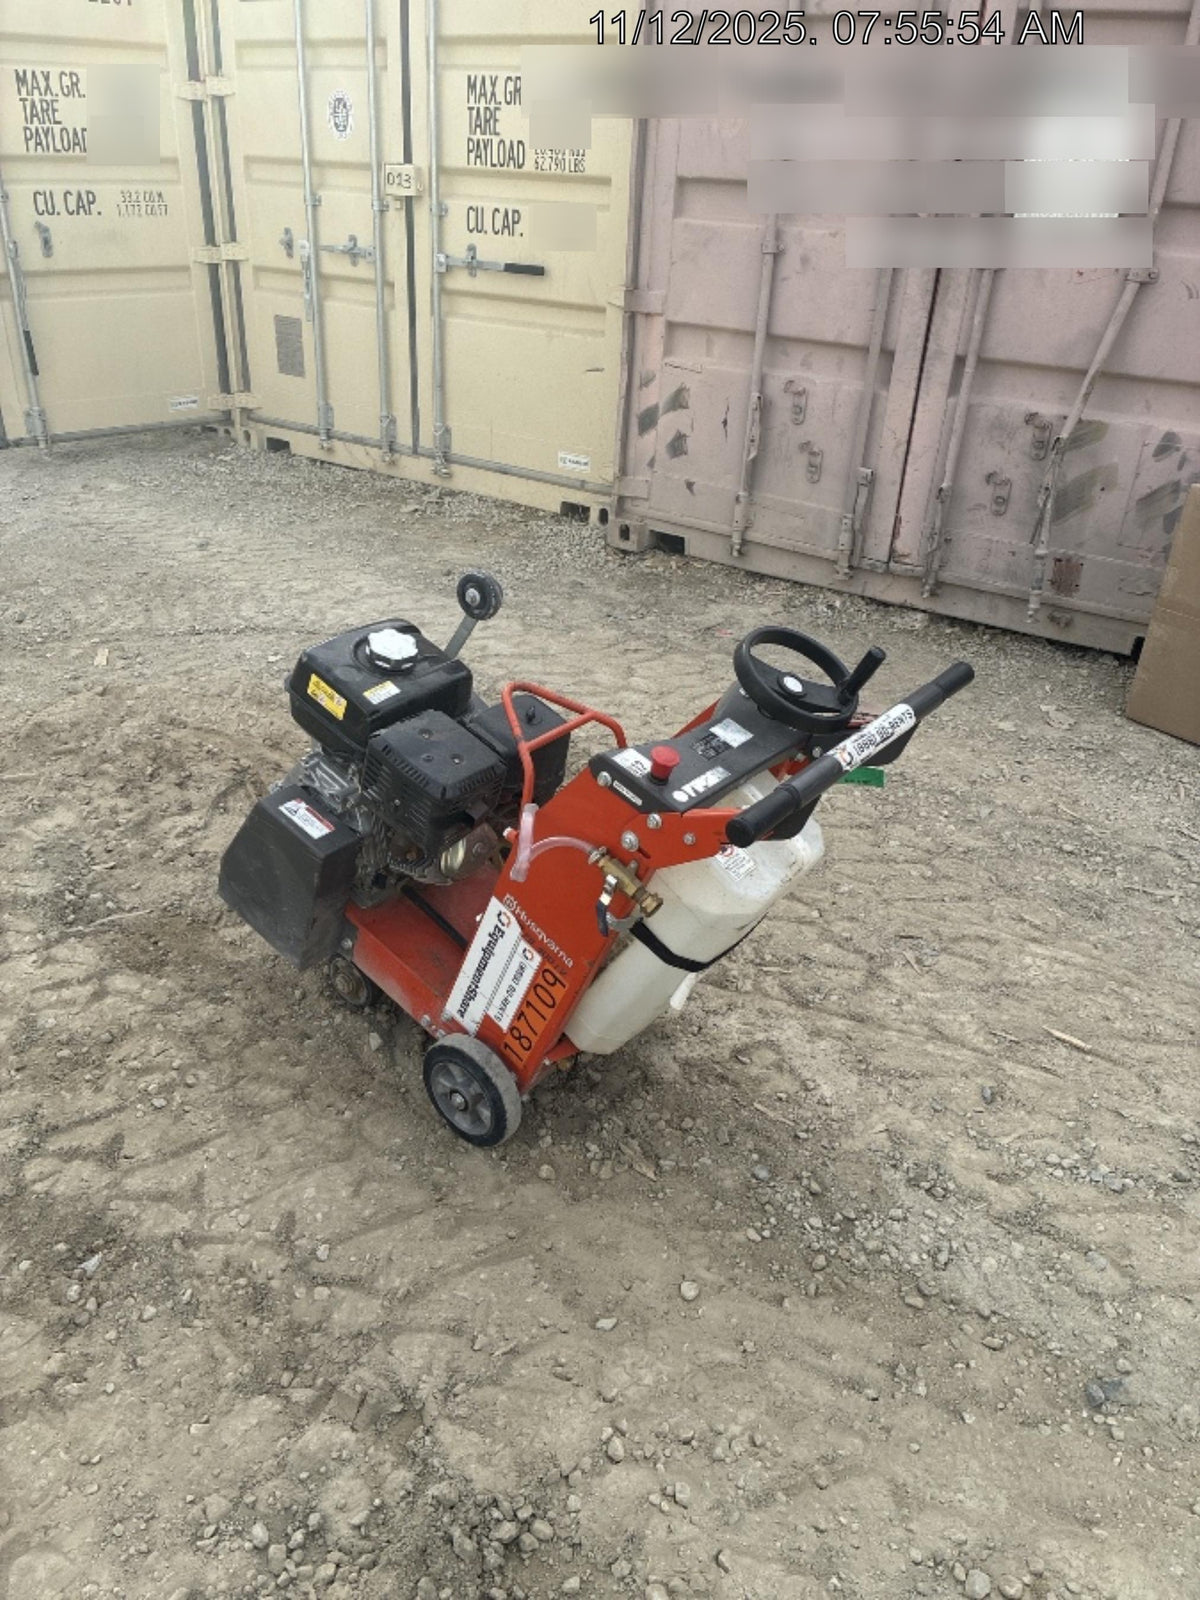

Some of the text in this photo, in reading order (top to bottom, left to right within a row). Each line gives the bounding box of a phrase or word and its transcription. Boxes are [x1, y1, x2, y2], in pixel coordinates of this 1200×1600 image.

[19, 98, 63, 126] TARE
[467, 106, 501, 136] TARE
[467, 138, 526, 170] PAYLOAD
[568, 157, 586, 173] LBS
[513, 899, 574, 969] Husqvarna
[457, 922, 506, 1019] EquipmentShare
[503, 967, 568, 1064] 187109
